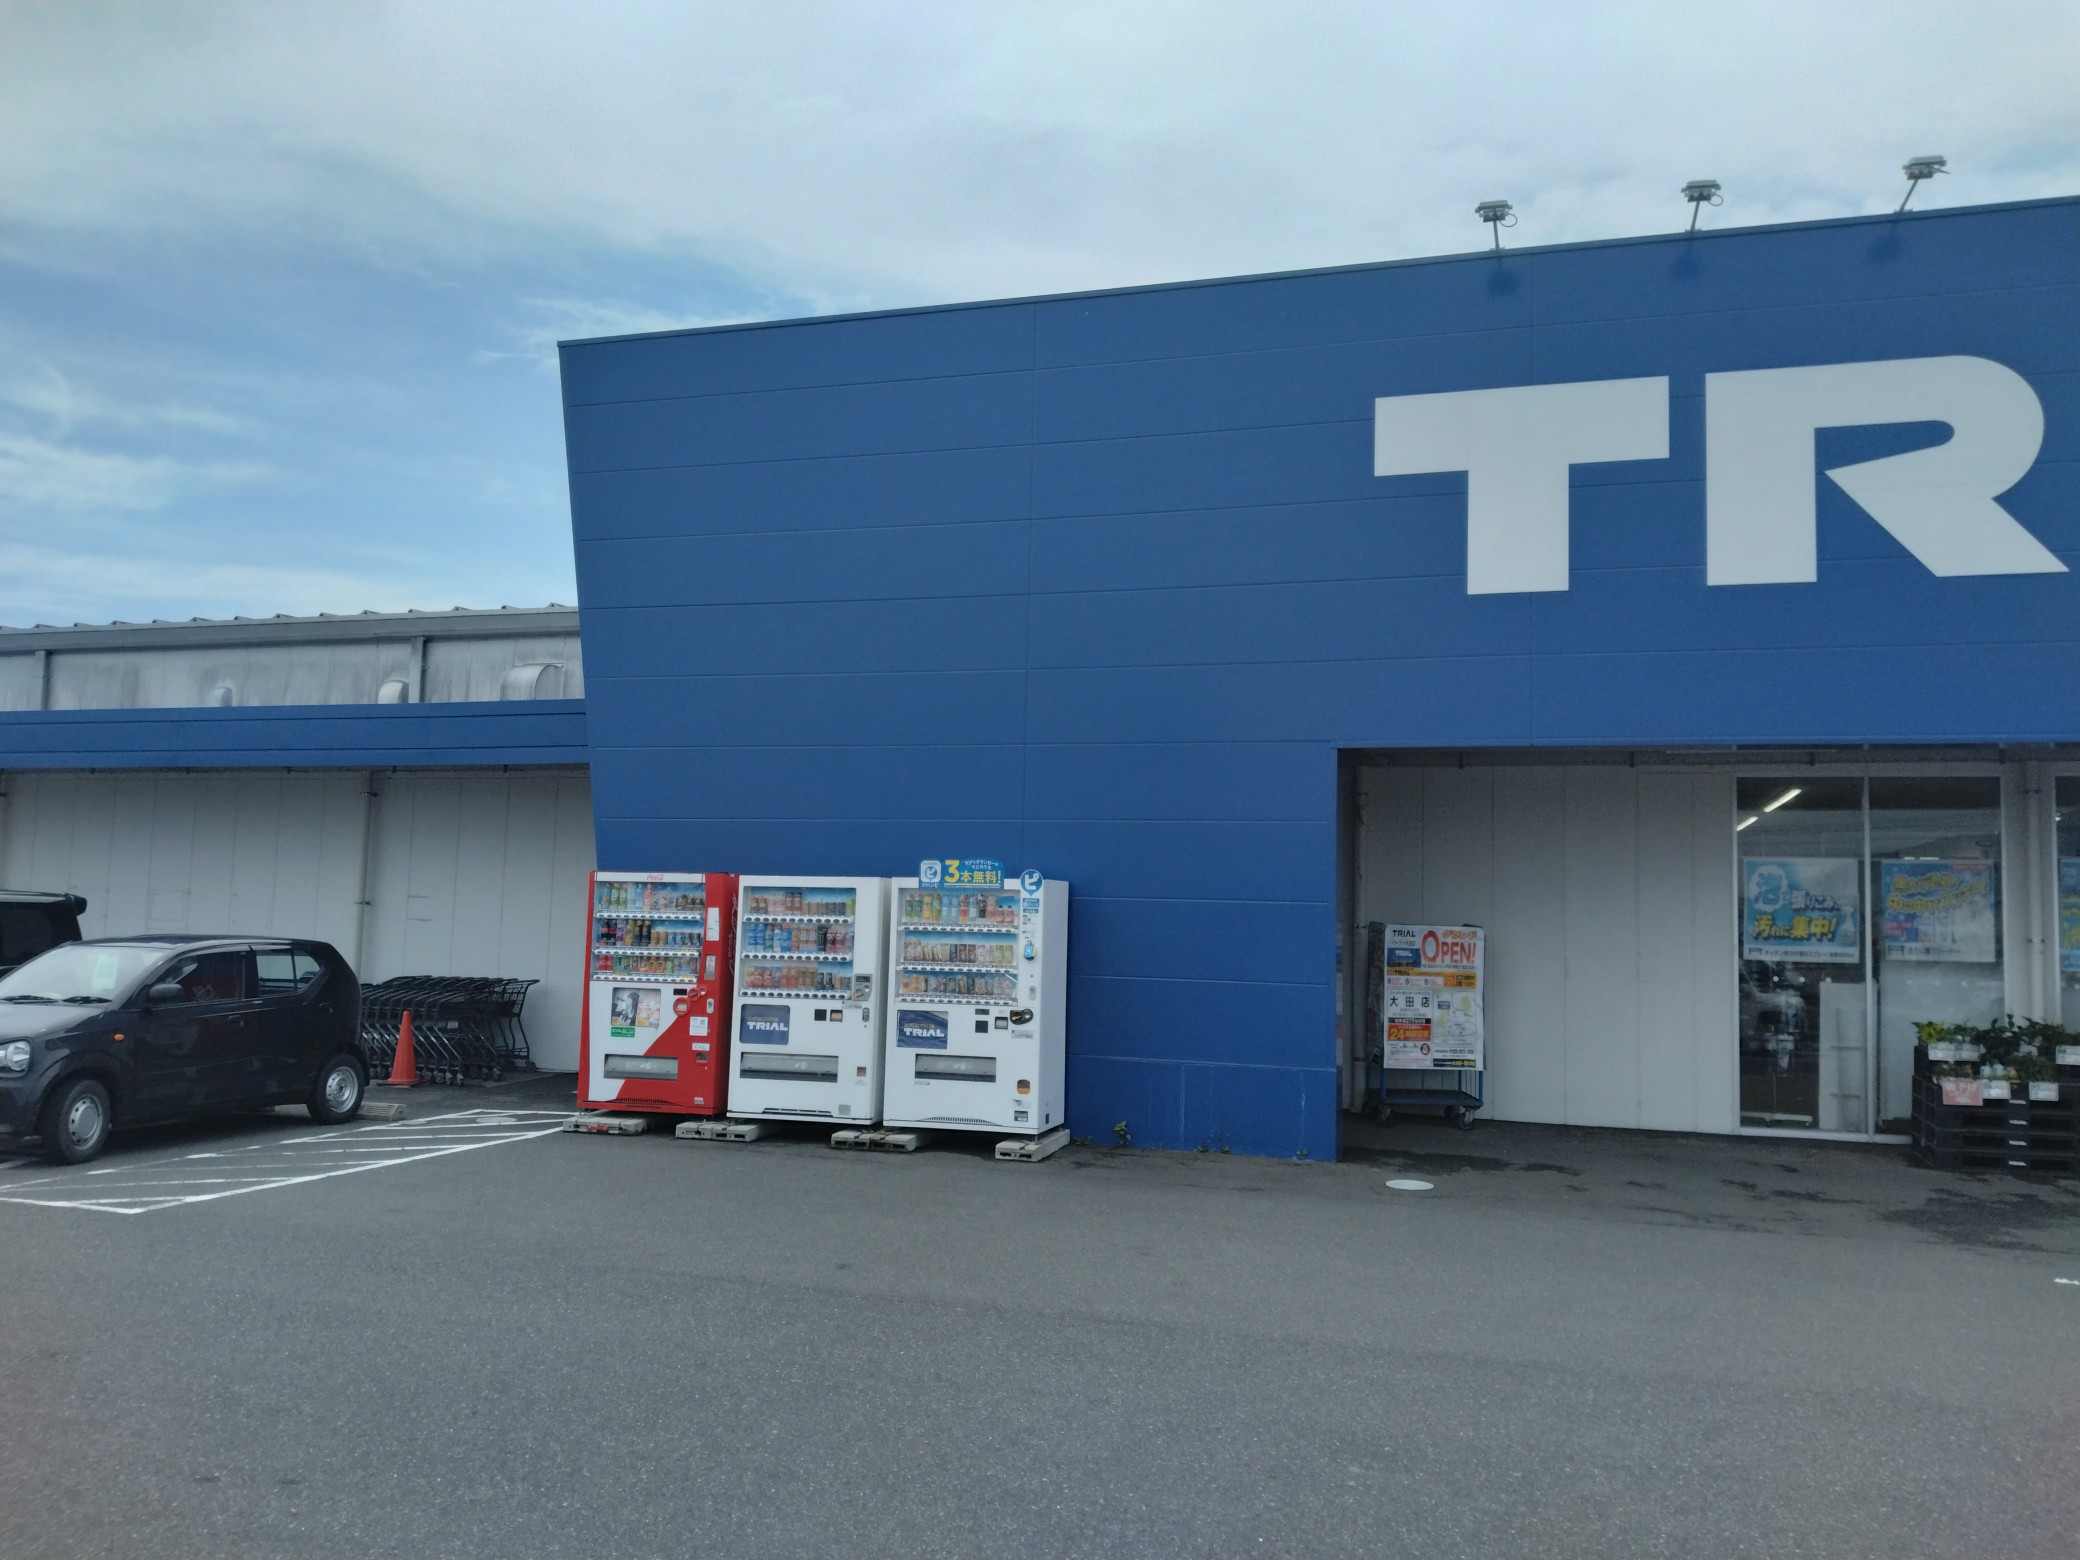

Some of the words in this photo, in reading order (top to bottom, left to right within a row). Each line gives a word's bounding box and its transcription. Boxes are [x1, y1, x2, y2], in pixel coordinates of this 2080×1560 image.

[1422, 930, 1476, 963] OPEN!
[1390, 996, 1430, 1007] 大田店
[748, 1022, 788, 1031] TRIAL
[904, 1028, 944, 1037] TRIAL
